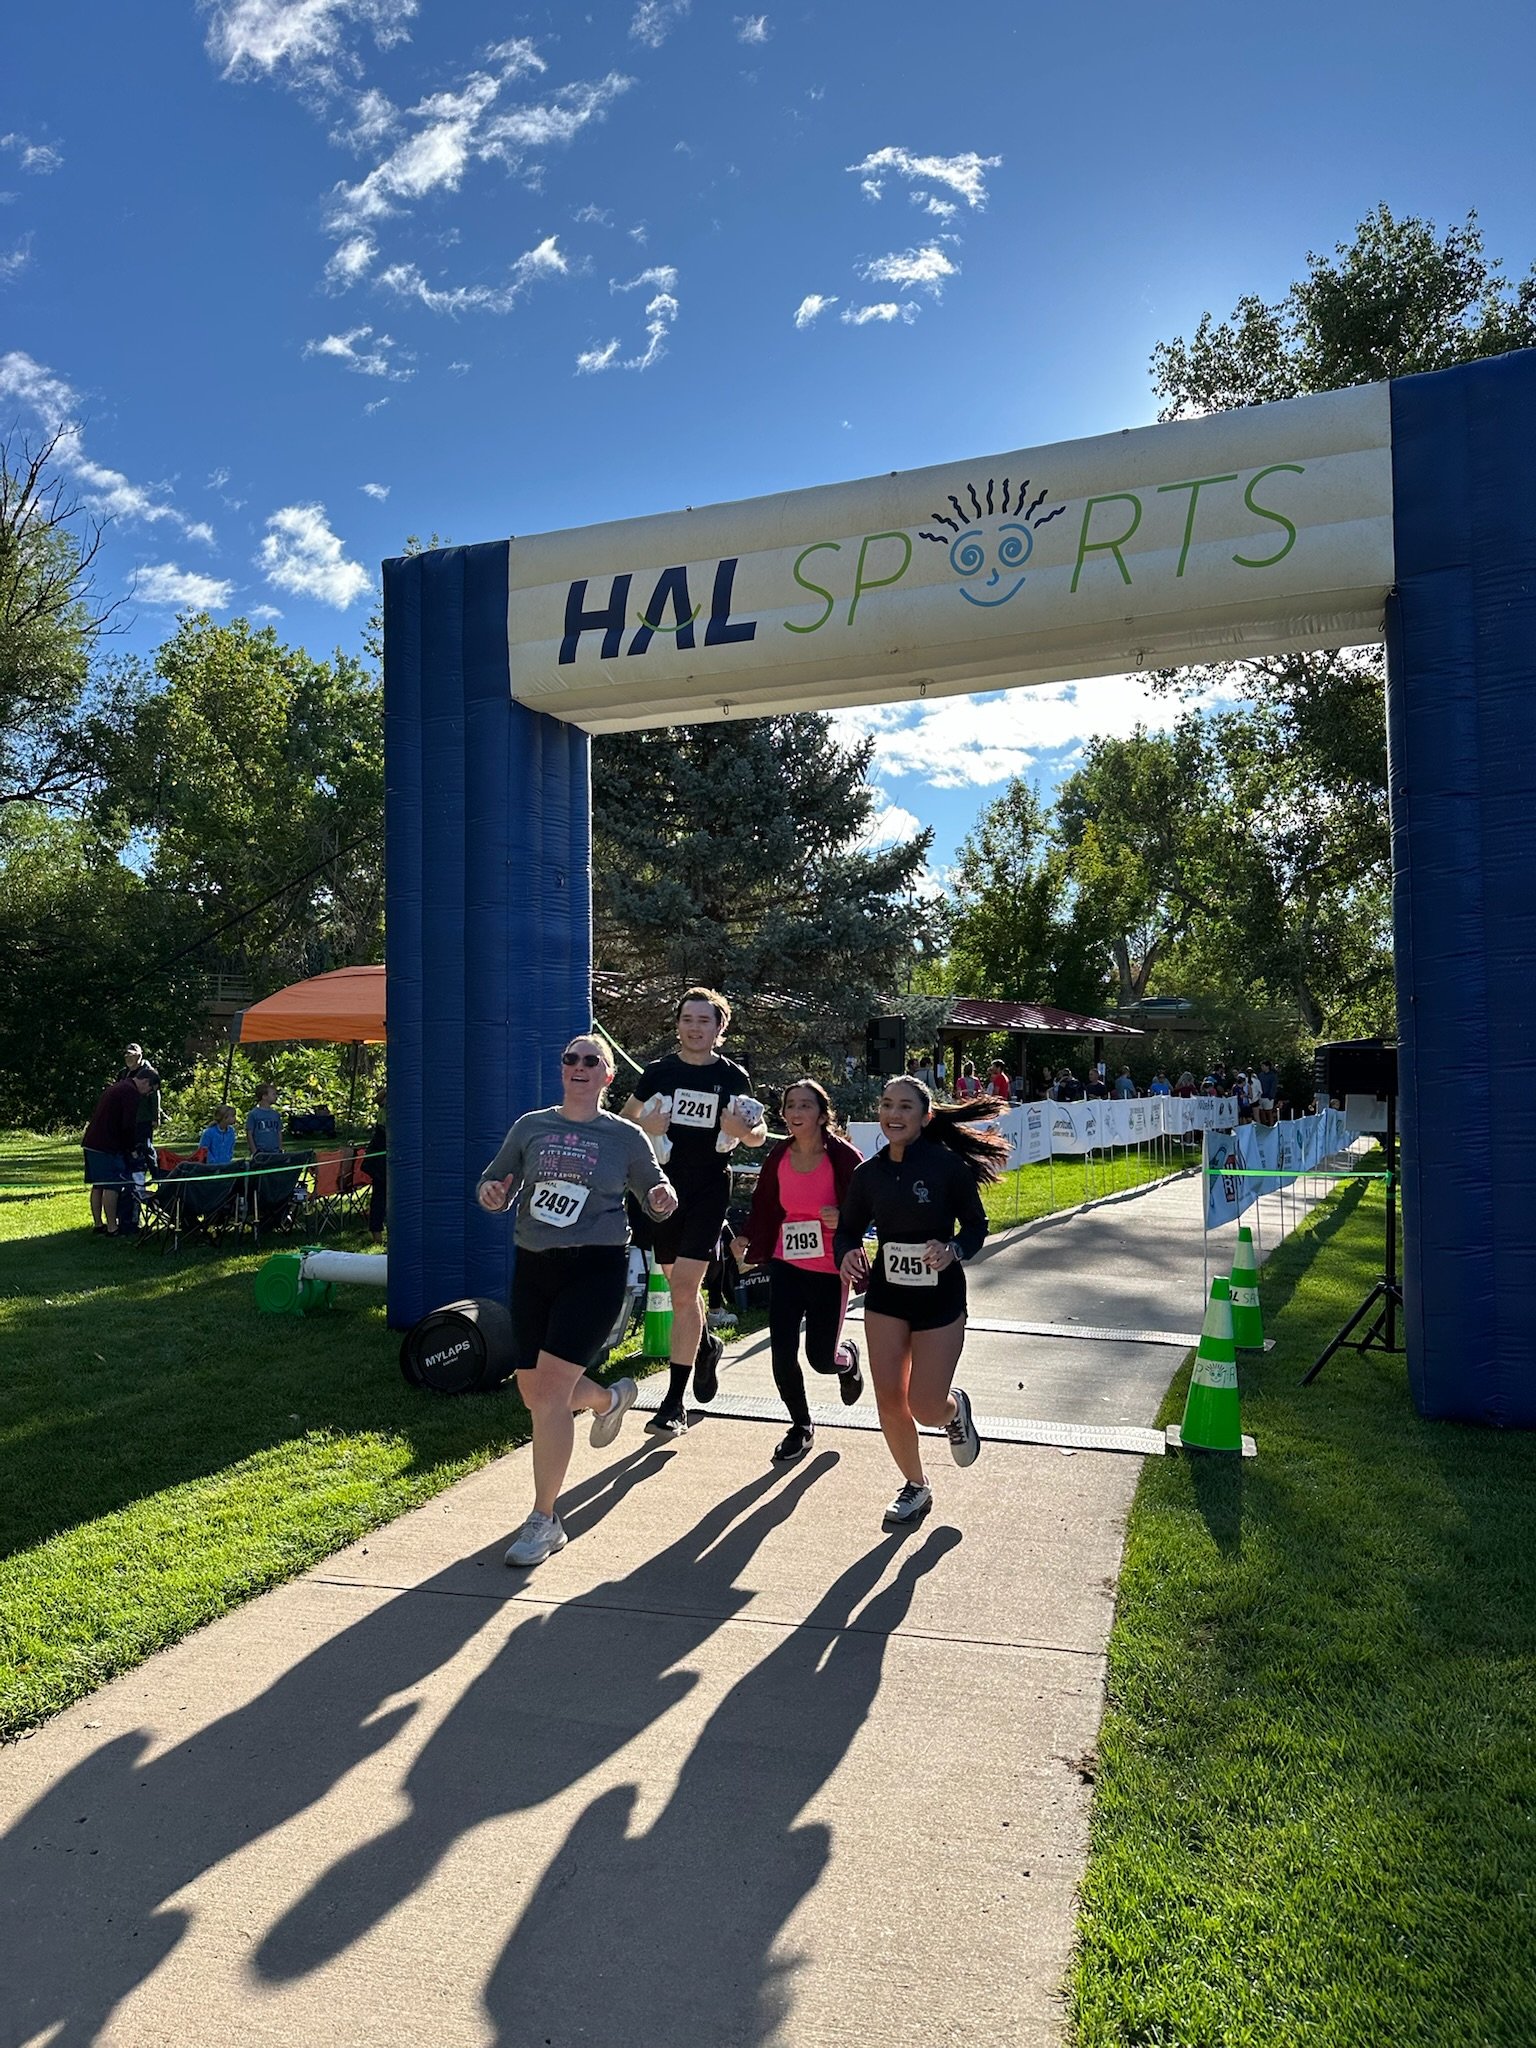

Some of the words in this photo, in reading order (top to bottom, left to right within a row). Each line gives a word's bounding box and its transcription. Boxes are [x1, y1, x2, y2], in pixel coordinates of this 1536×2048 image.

[558, 558, 758, 666] HAL
[677, 1099, 712, 1119] 2241
[562, 1151, 586, 1159] ABOUT
[534, 1190, 580, 1218] 2497
[785, 1232, 819, 1251] 2193
[425, 1340, 471, 1367] MYLAPS
